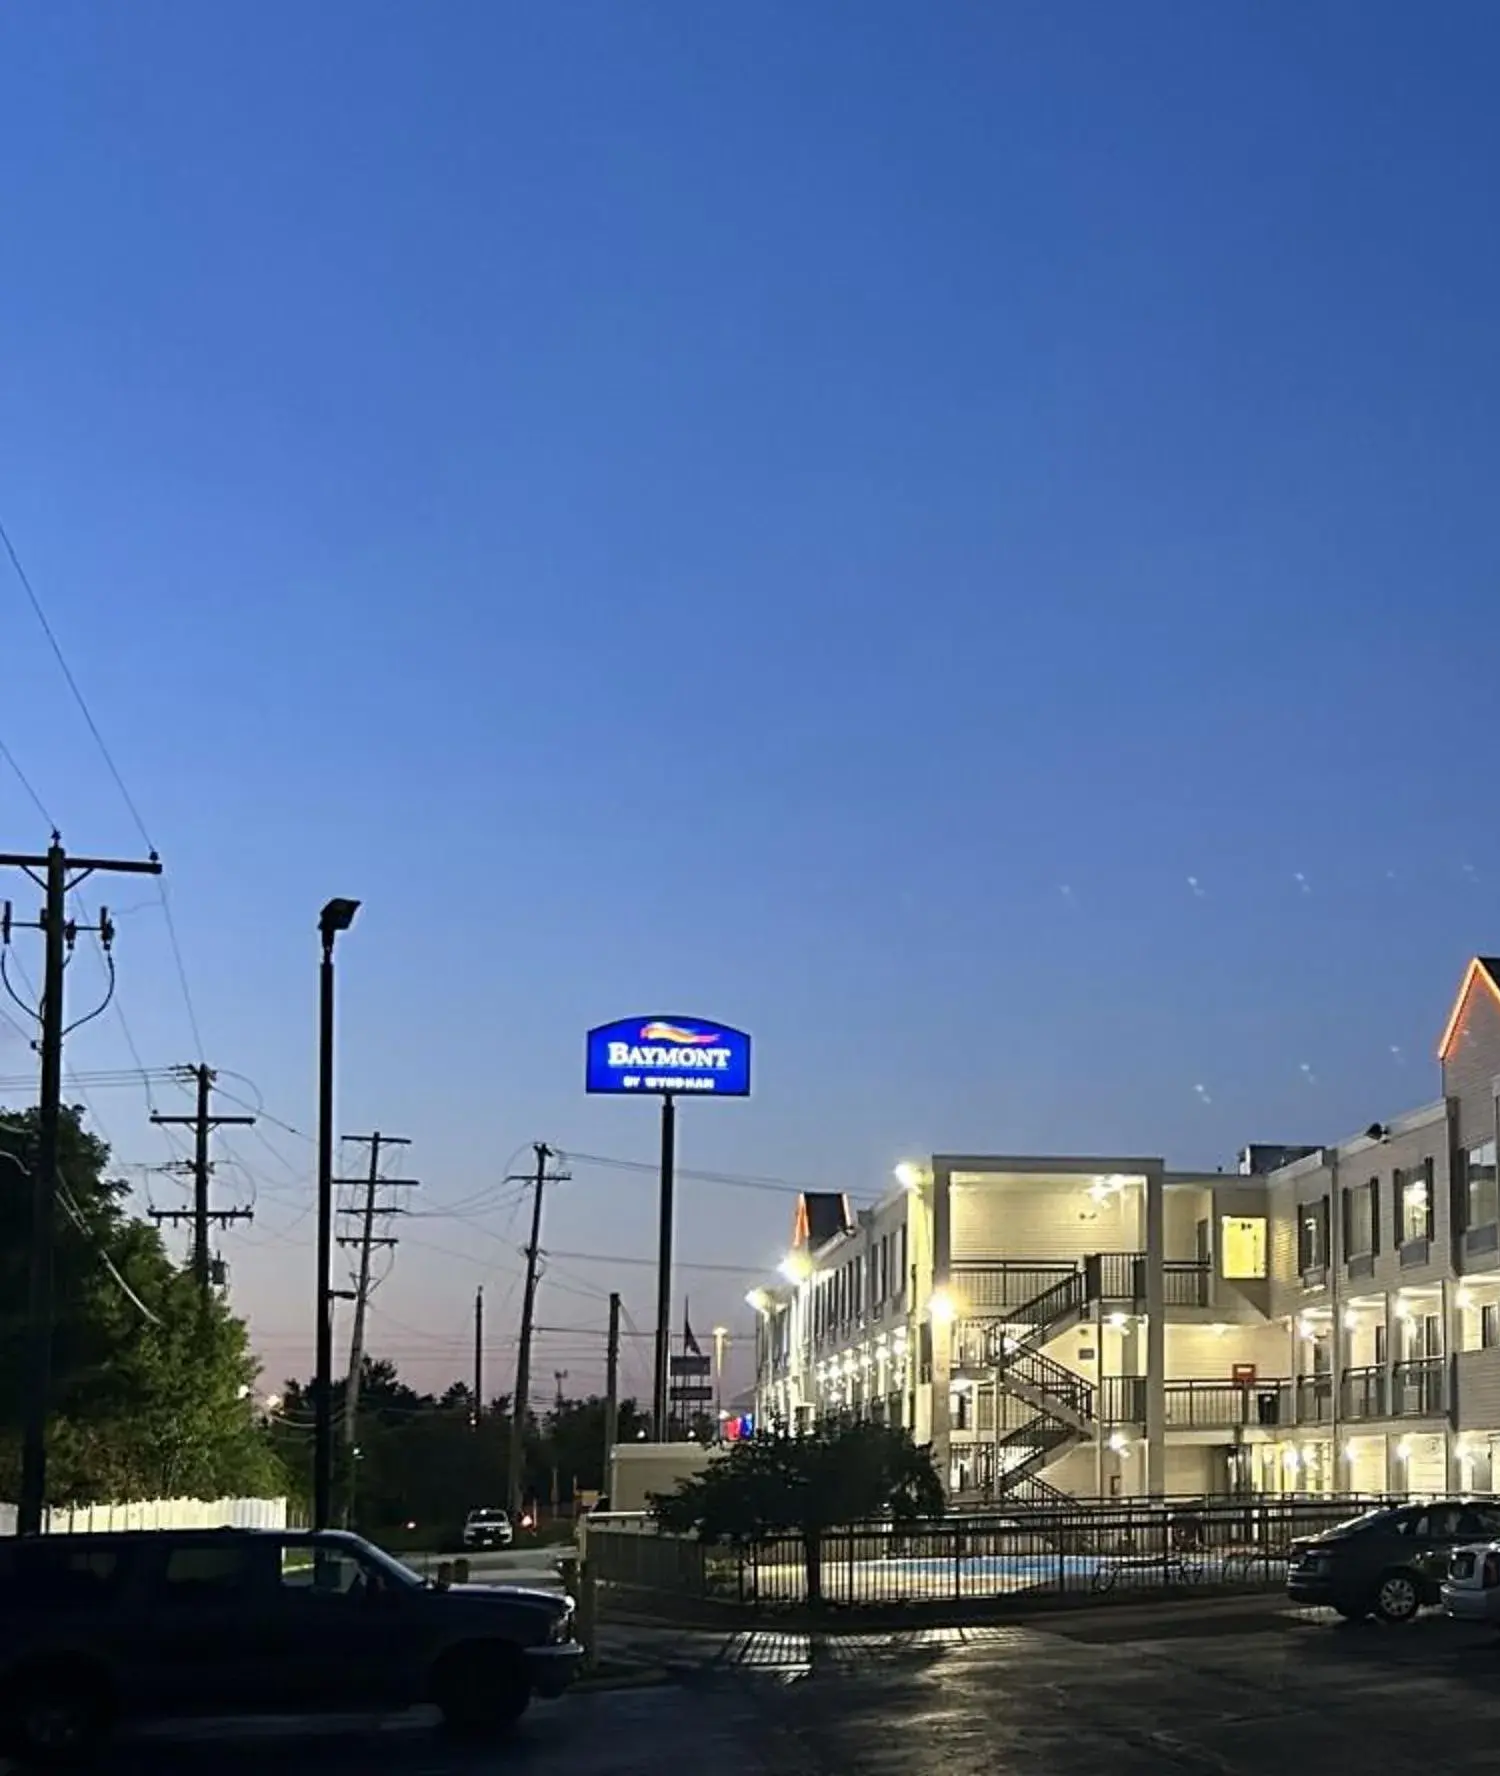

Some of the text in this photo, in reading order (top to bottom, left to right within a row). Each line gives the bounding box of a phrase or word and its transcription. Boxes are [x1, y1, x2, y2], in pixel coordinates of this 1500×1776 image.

[608, 1041, 732, 1069] BAYMONT
[623, 1075, 715, 1089] BY WYNDHAM
